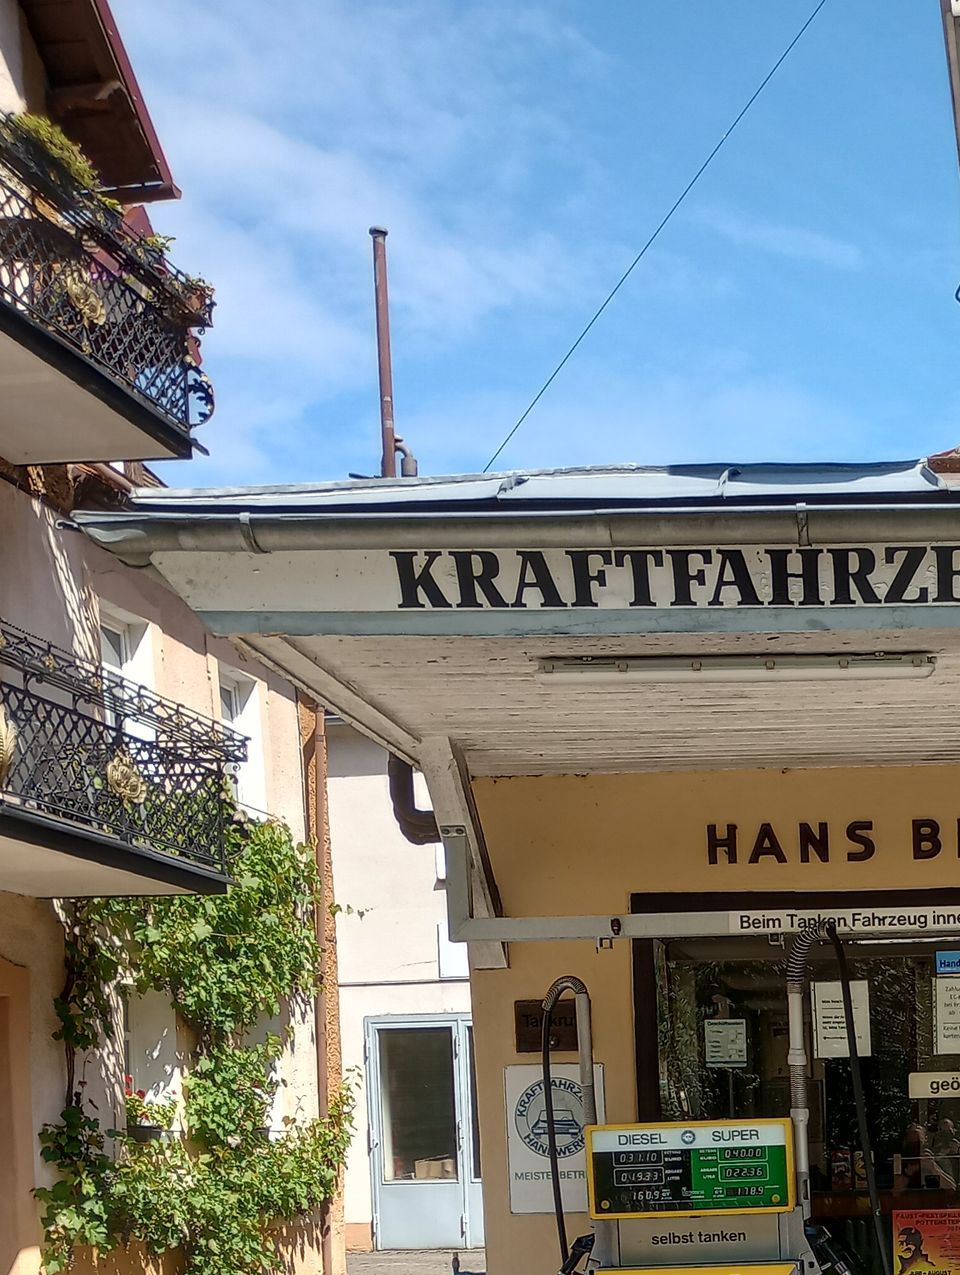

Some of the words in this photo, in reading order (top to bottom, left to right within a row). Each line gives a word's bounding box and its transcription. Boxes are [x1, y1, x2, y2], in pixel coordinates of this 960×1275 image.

[706, 820, 876, 865] HANS
[739, 914, 782, 930] Beim
[852, 912, 928, 929] Fahrzeug
[618, 1133, 667, 1146] DIESEL
[712, 1129, 760, 1142] SUPER
[523, 1133, 585, 1157] HANWERK
[514, 1170, 585, 1181] MEISTEBETR
[651, 1231, 694, 1245] selbst
[698, 1229, 747, 1244] tanken
